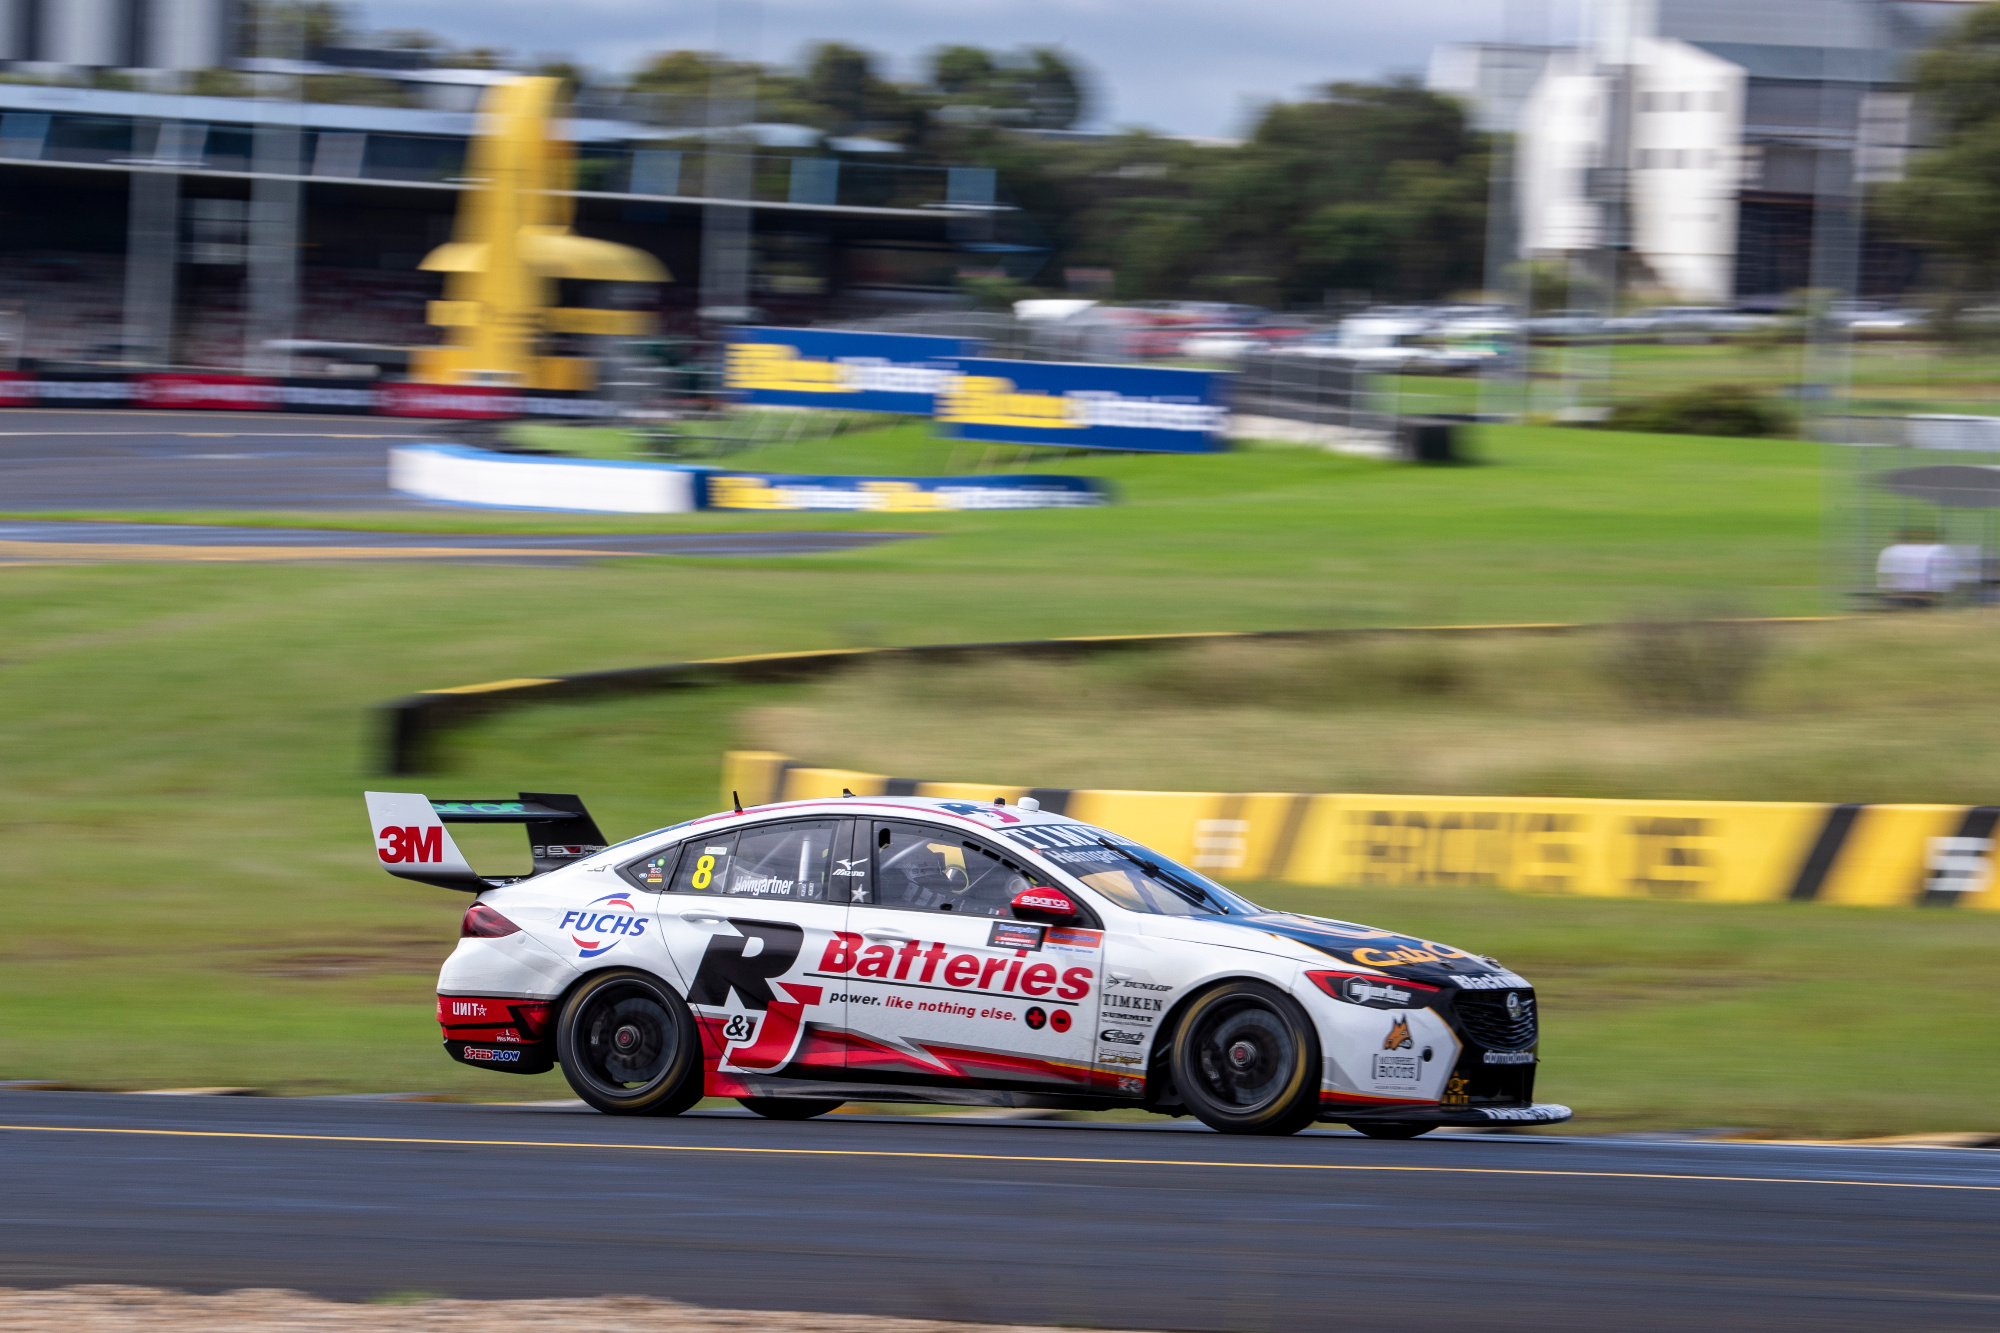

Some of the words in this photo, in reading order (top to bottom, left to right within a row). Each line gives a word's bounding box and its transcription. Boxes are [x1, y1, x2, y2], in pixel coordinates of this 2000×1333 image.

[378, 826, 442, 864] 3M
[691, 854, 716, 890] 8
[1021, 895, 1070, 909] sparco
[559, 910, 650, 937] FUCHS
[818, 930, 1094, 1001] Batteries
[686, 917, 824, 1073] R&J
[1123, 981, 1174, 991] DUNLOP
[829, 991, 881, 1005] power.
[885, 995, 914, 1010] like
[917, 1002, 976, 1019] nothing
[980, 1007, 1018, 1022] else.
[1103, 993, 1163, 1011] TIMKEN
[1101, 1011, 1154, 1022] SUMMIT
[464, 1046, 520, 1061] SPEEDFLOW
